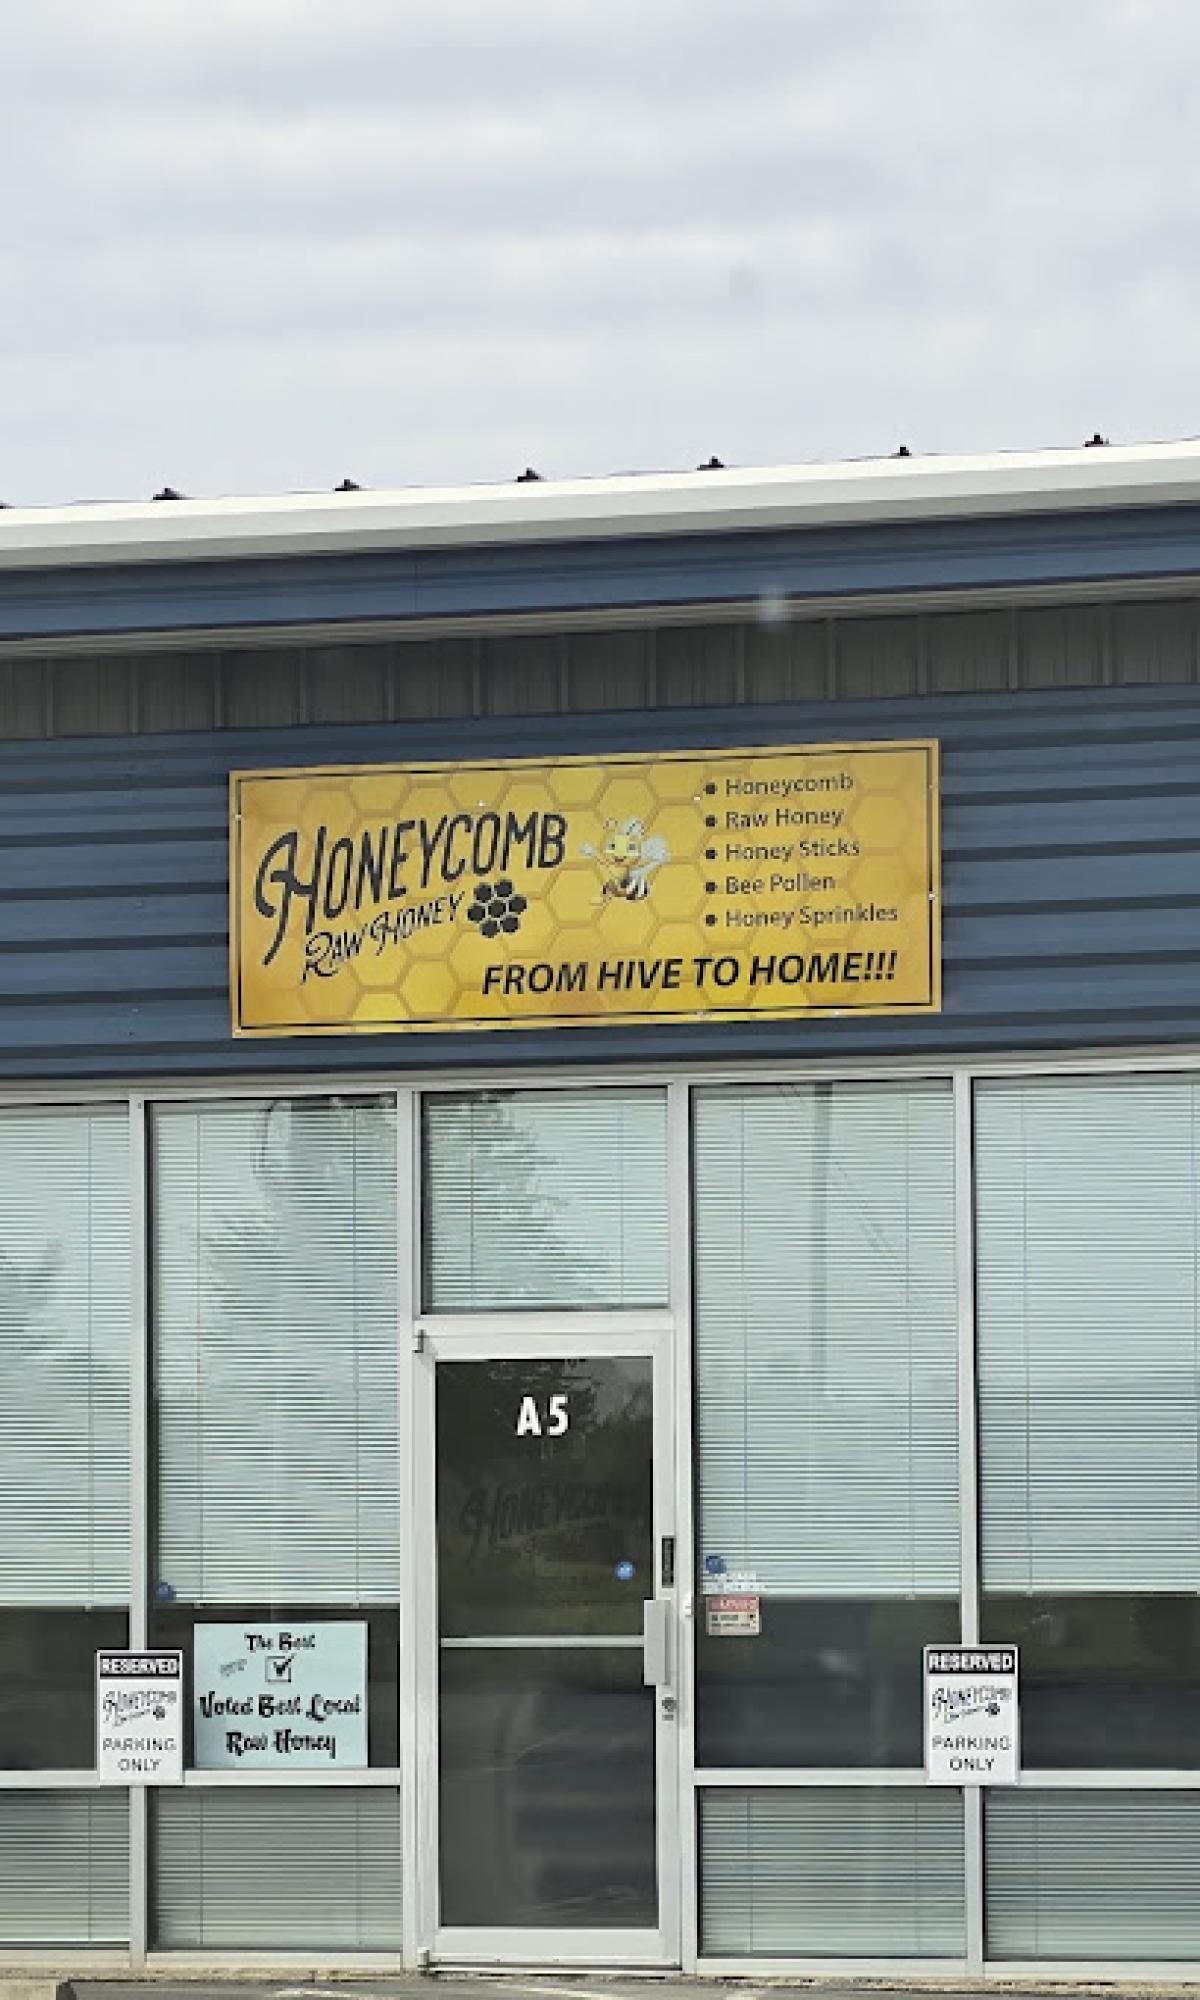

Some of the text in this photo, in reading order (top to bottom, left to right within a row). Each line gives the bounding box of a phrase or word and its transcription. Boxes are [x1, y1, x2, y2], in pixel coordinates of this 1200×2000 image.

[726, 772, 854, 798] Honeycomb
[726, 807, 845, 830] Raw Honey
[726, 839, 861, 864] Honey Sticks
[254, 810, 568, 967] HONEYCOMB
[726, 873, 836, 895] Bee Pollen
[726, 902, 898, 930] Honey Sprinkles
[301, 890, 466, 986] RAW HONEY
[482, 950, 899, 996] FROM HIVE TO HOME!!!
[516, 1394, 570, 1437] A5
[244, 1632, 316, 1653] The Best
[101, 1658, 178, 1675] RESERVED
[928, 1652, 1014, 1672] RESERVED
[200, 1690, 360, 1723] Voted Best Local
[102, 1737, 177, 1751] PARKING
[226, 1728, 337, 1759] Raw Honey
[932, 1735, 1012, 1751] PARKING
[117, 1758, 161, 1771] ONLY
[949, 1756, 995, 1771] ONLY
